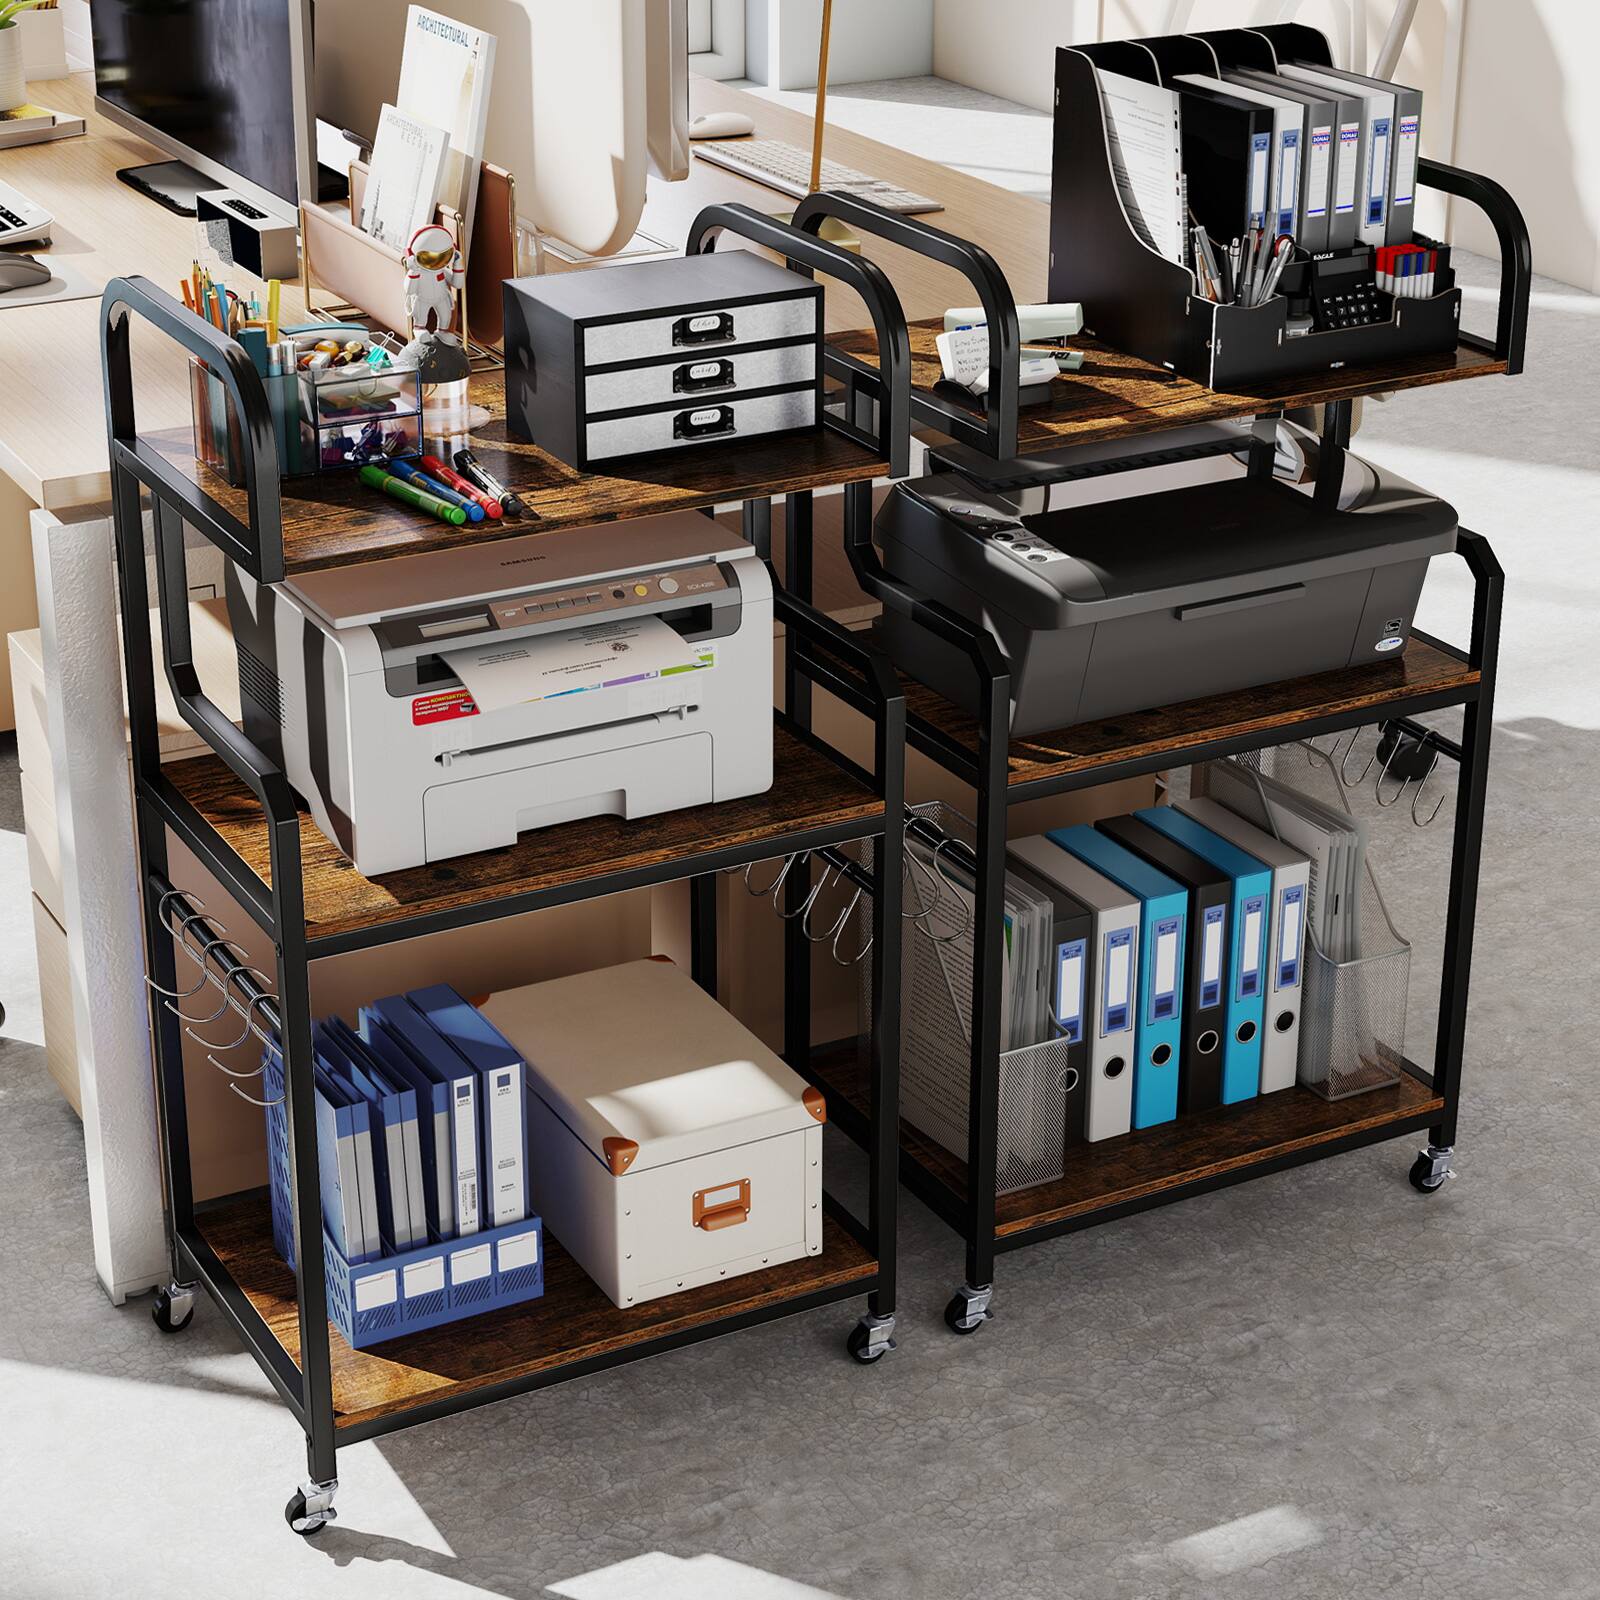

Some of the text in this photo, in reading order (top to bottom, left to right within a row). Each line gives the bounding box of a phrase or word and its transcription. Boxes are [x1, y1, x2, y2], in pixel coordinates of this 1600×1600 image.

[417, 14, 469, 48] ARCHITECTURAL
[1313, 135, 1329, 143] DONAU
[500, 555, 546, 566] SAMSUNG
[430, 692, 470, 702] КОМПАКТНО
